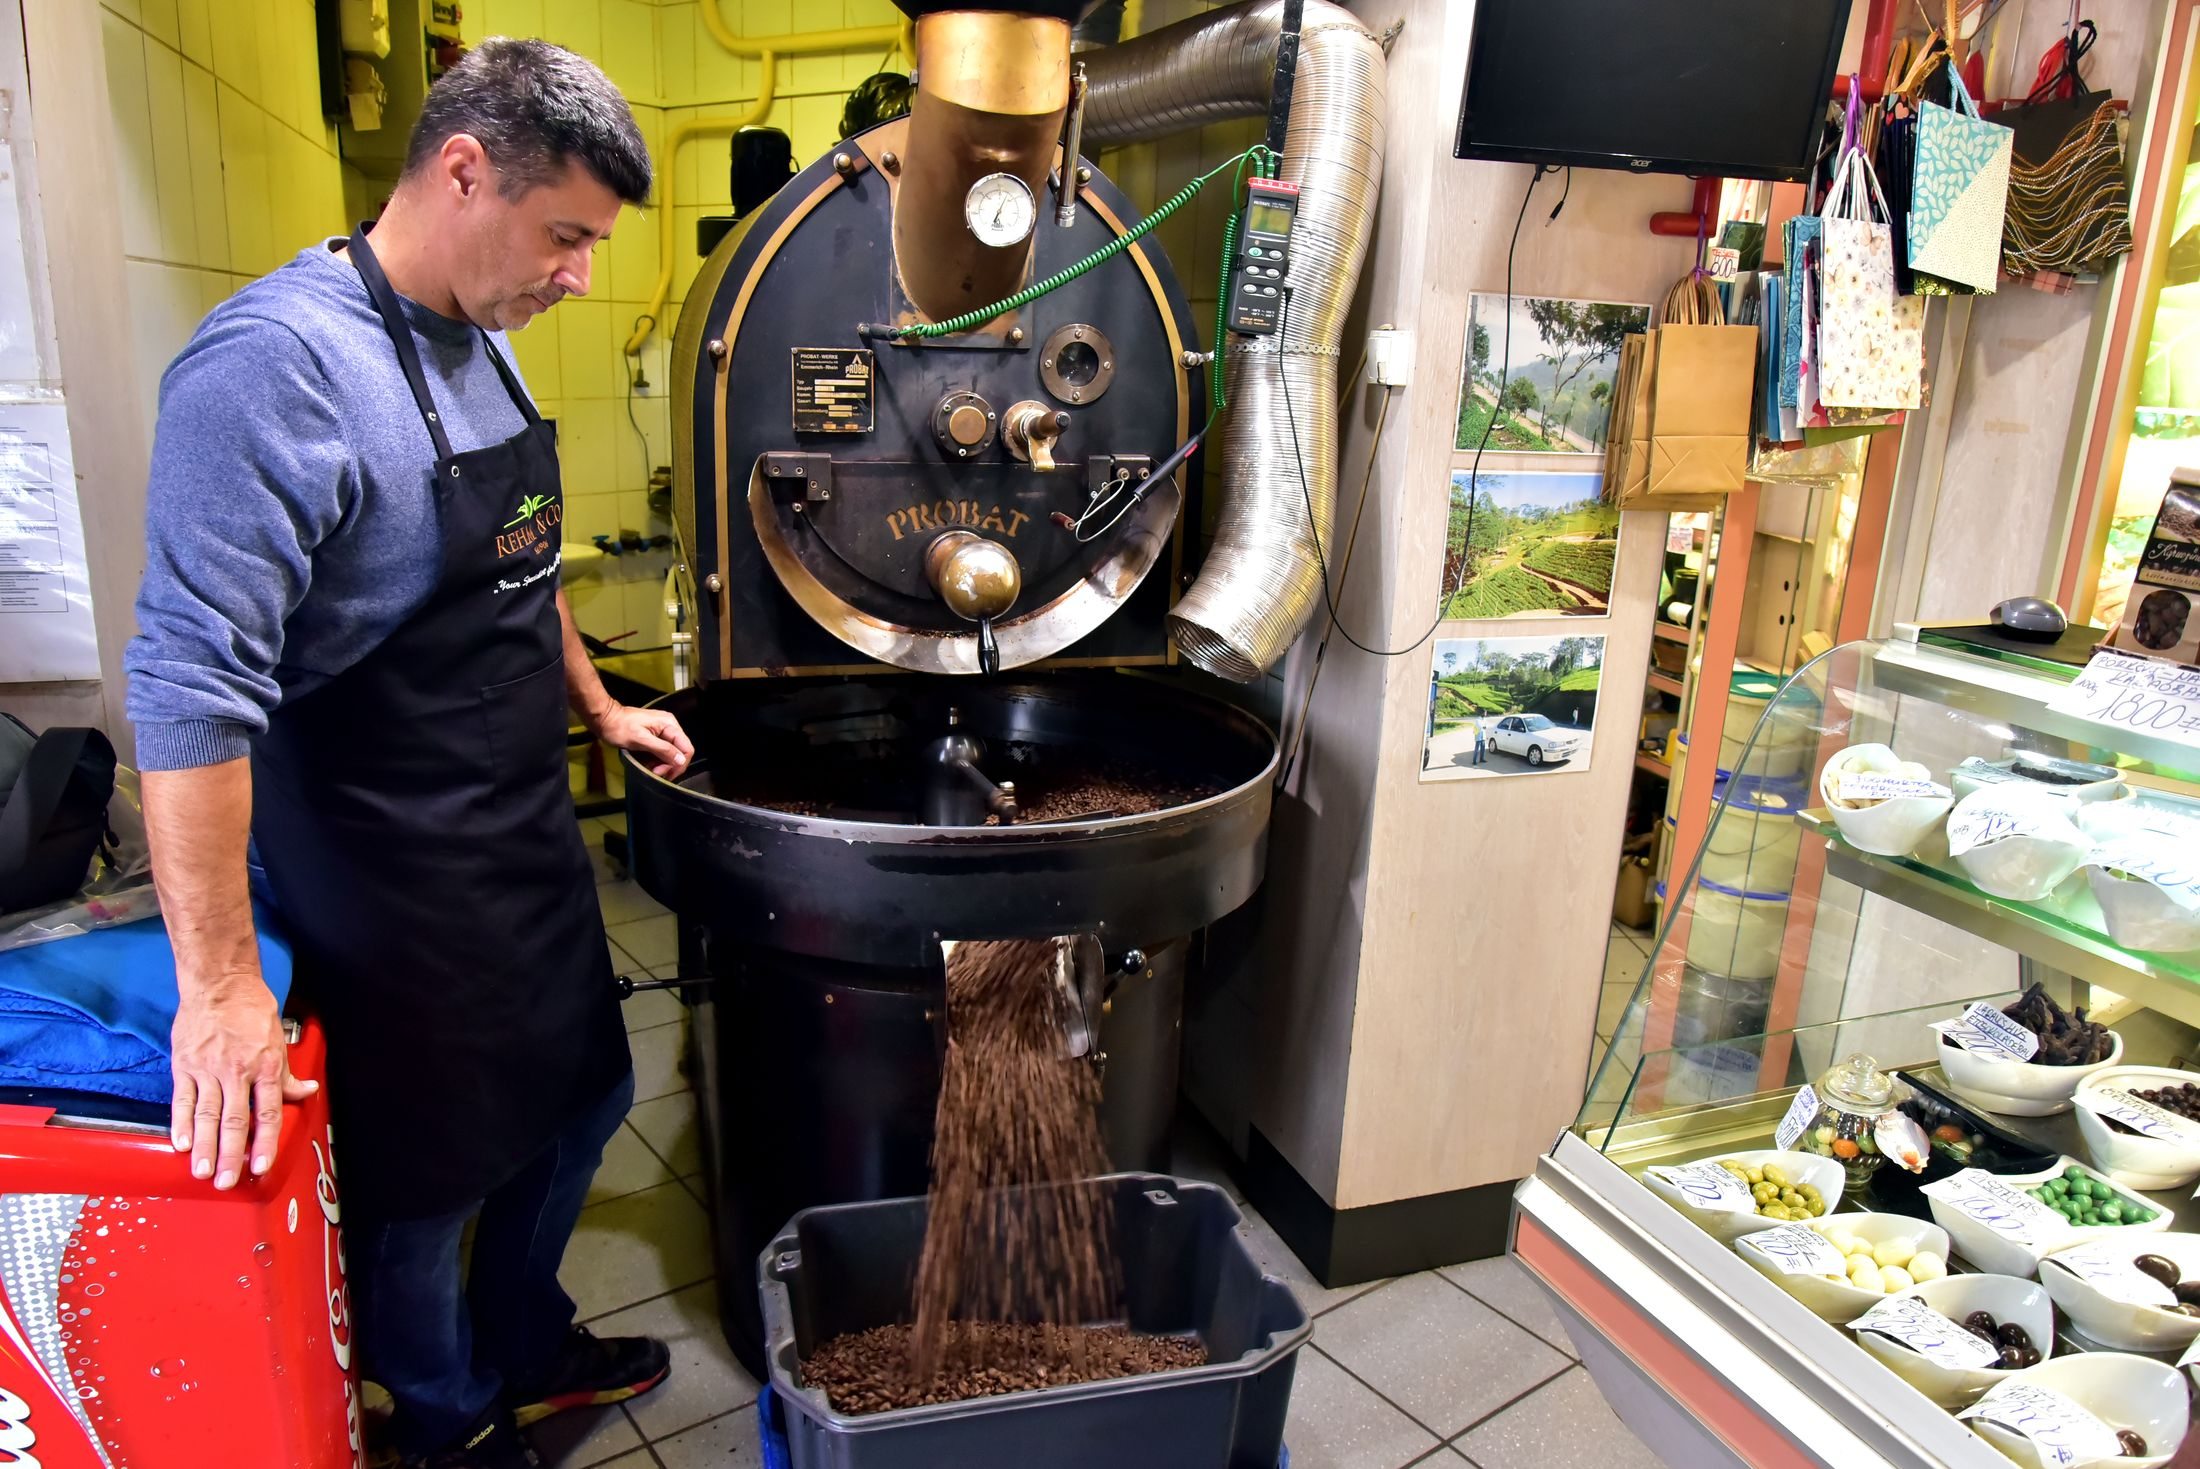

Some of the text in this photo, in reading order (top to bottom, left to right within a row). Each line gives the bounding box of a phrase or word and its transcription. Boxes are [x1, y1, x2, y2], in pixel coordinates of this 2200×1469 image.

[1631, 159, 1652, 168] acer
[1711, 254, 1733, 278] 800
[845, 364, 869, 375] PROBAT
[886, 500, 1030, 541] PROBAT
[495, 525, 537, 558] REHM
[535, 512, 547, 535] &
[2088, 688, 2186, 729] 1800
[465, 1423, 495, 1449] adidas
